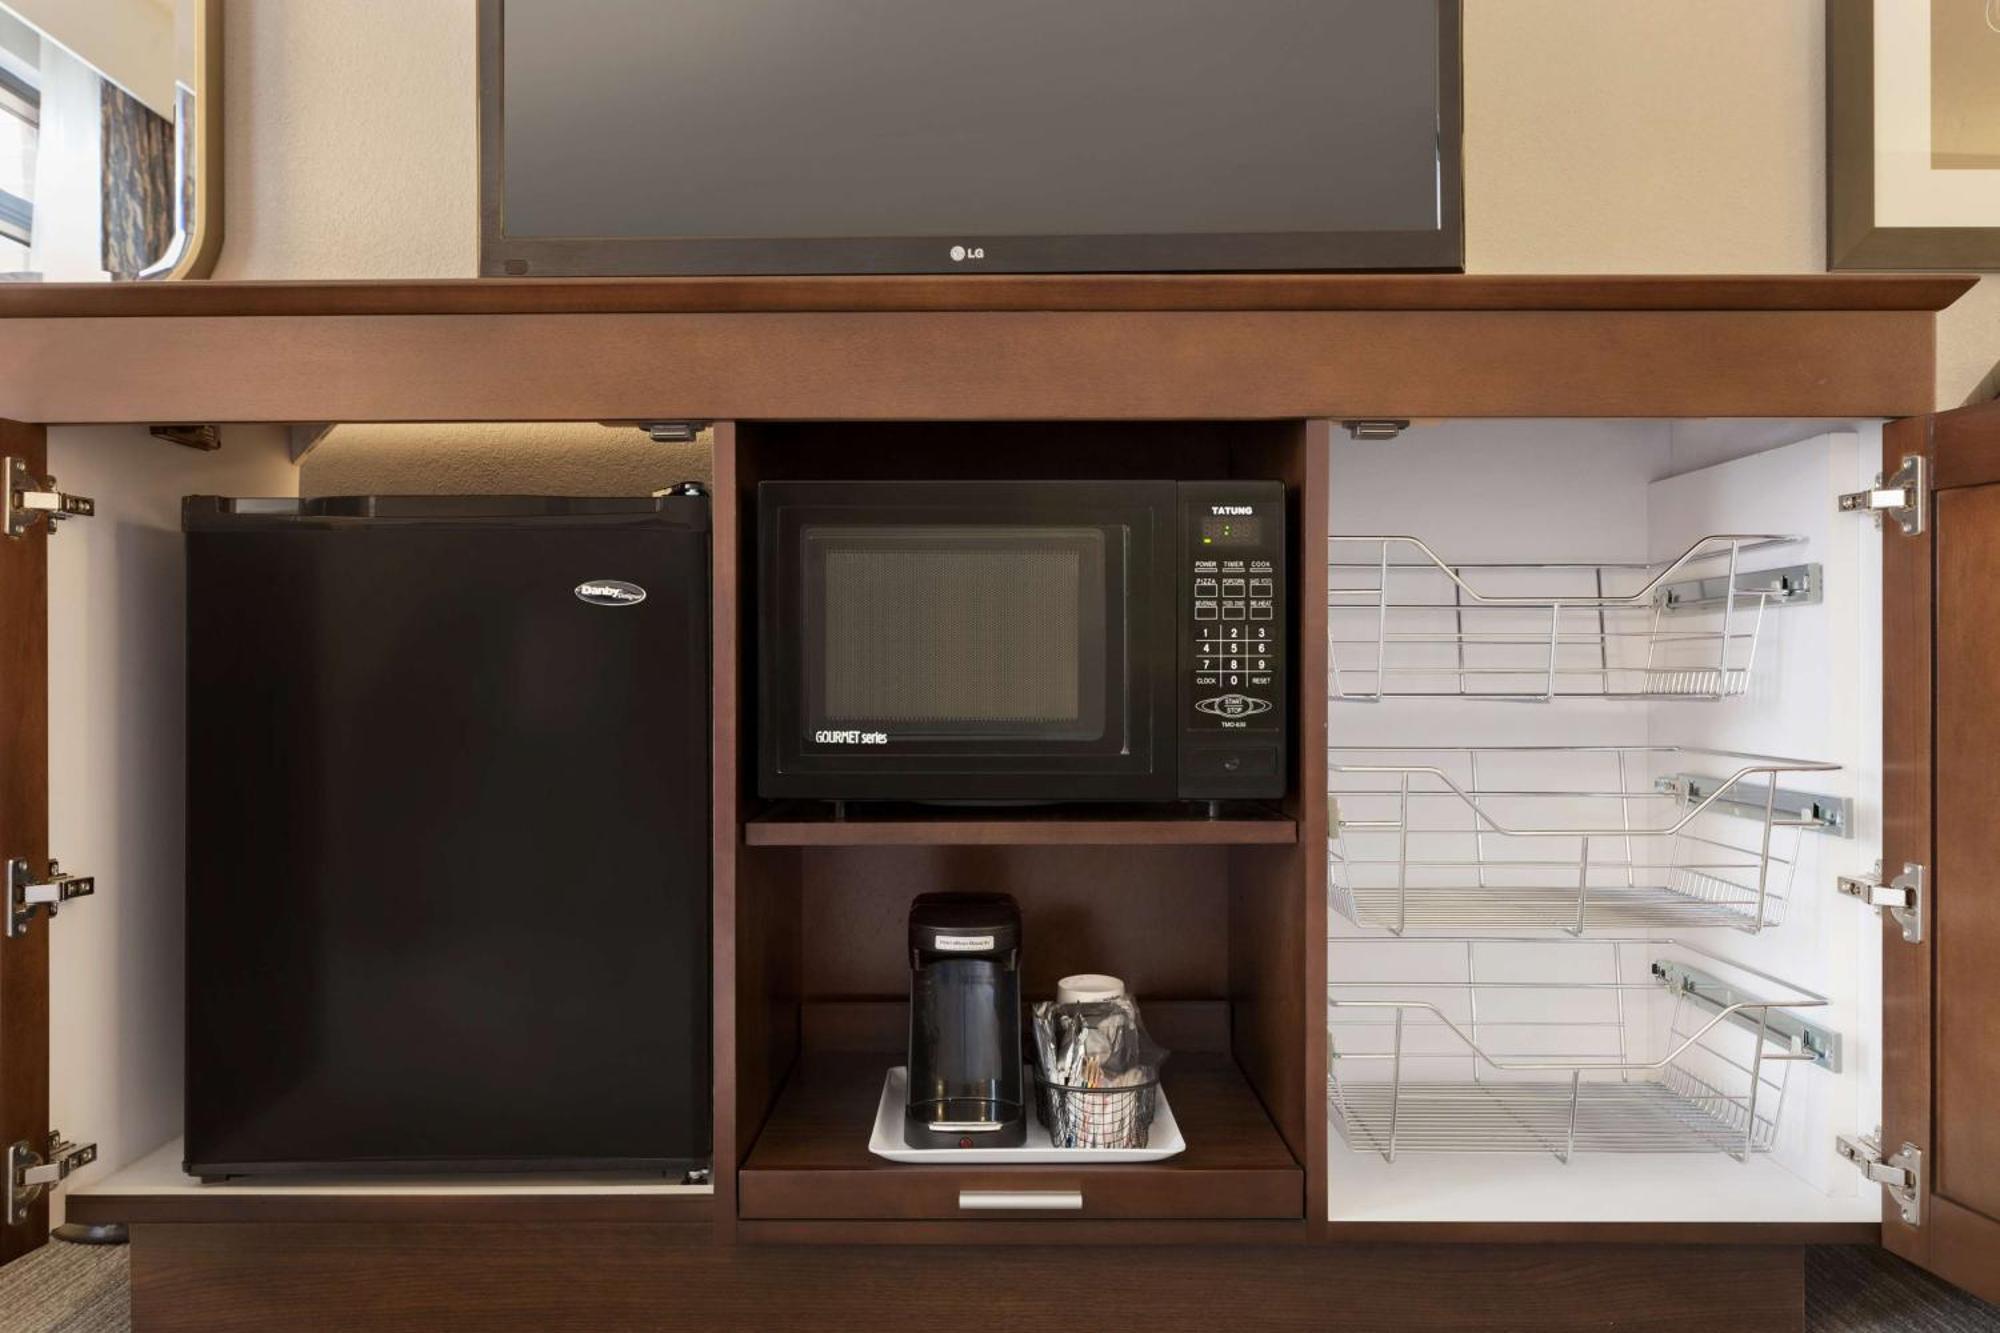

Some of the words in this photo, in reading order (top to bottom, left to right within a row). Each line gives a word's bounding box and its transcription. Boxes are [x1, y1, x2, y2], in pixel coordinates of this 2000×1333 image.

[967, 248, 984, 258] LG
[1211, 506, 1253, 515] TATUNG
[581, 584, 621, 598] Danby
[1203, 628, 1208, 638] 1
[1230, 628, 1238, 638] 2
[1258, 628, 1266, 638] 3
[1203, 643, 1210, 653] 4
[1230, 643, 1238, 653] 5
[1258, 643, 1266, 653] 6
[1203, 660, 1210, 669] 7
[1230, 660, 1238, 670] 8
[1258, 660, 1266, 670] 9
[815, 730, 861, 744] GOURMET
[861, 731, 888, 744] series
